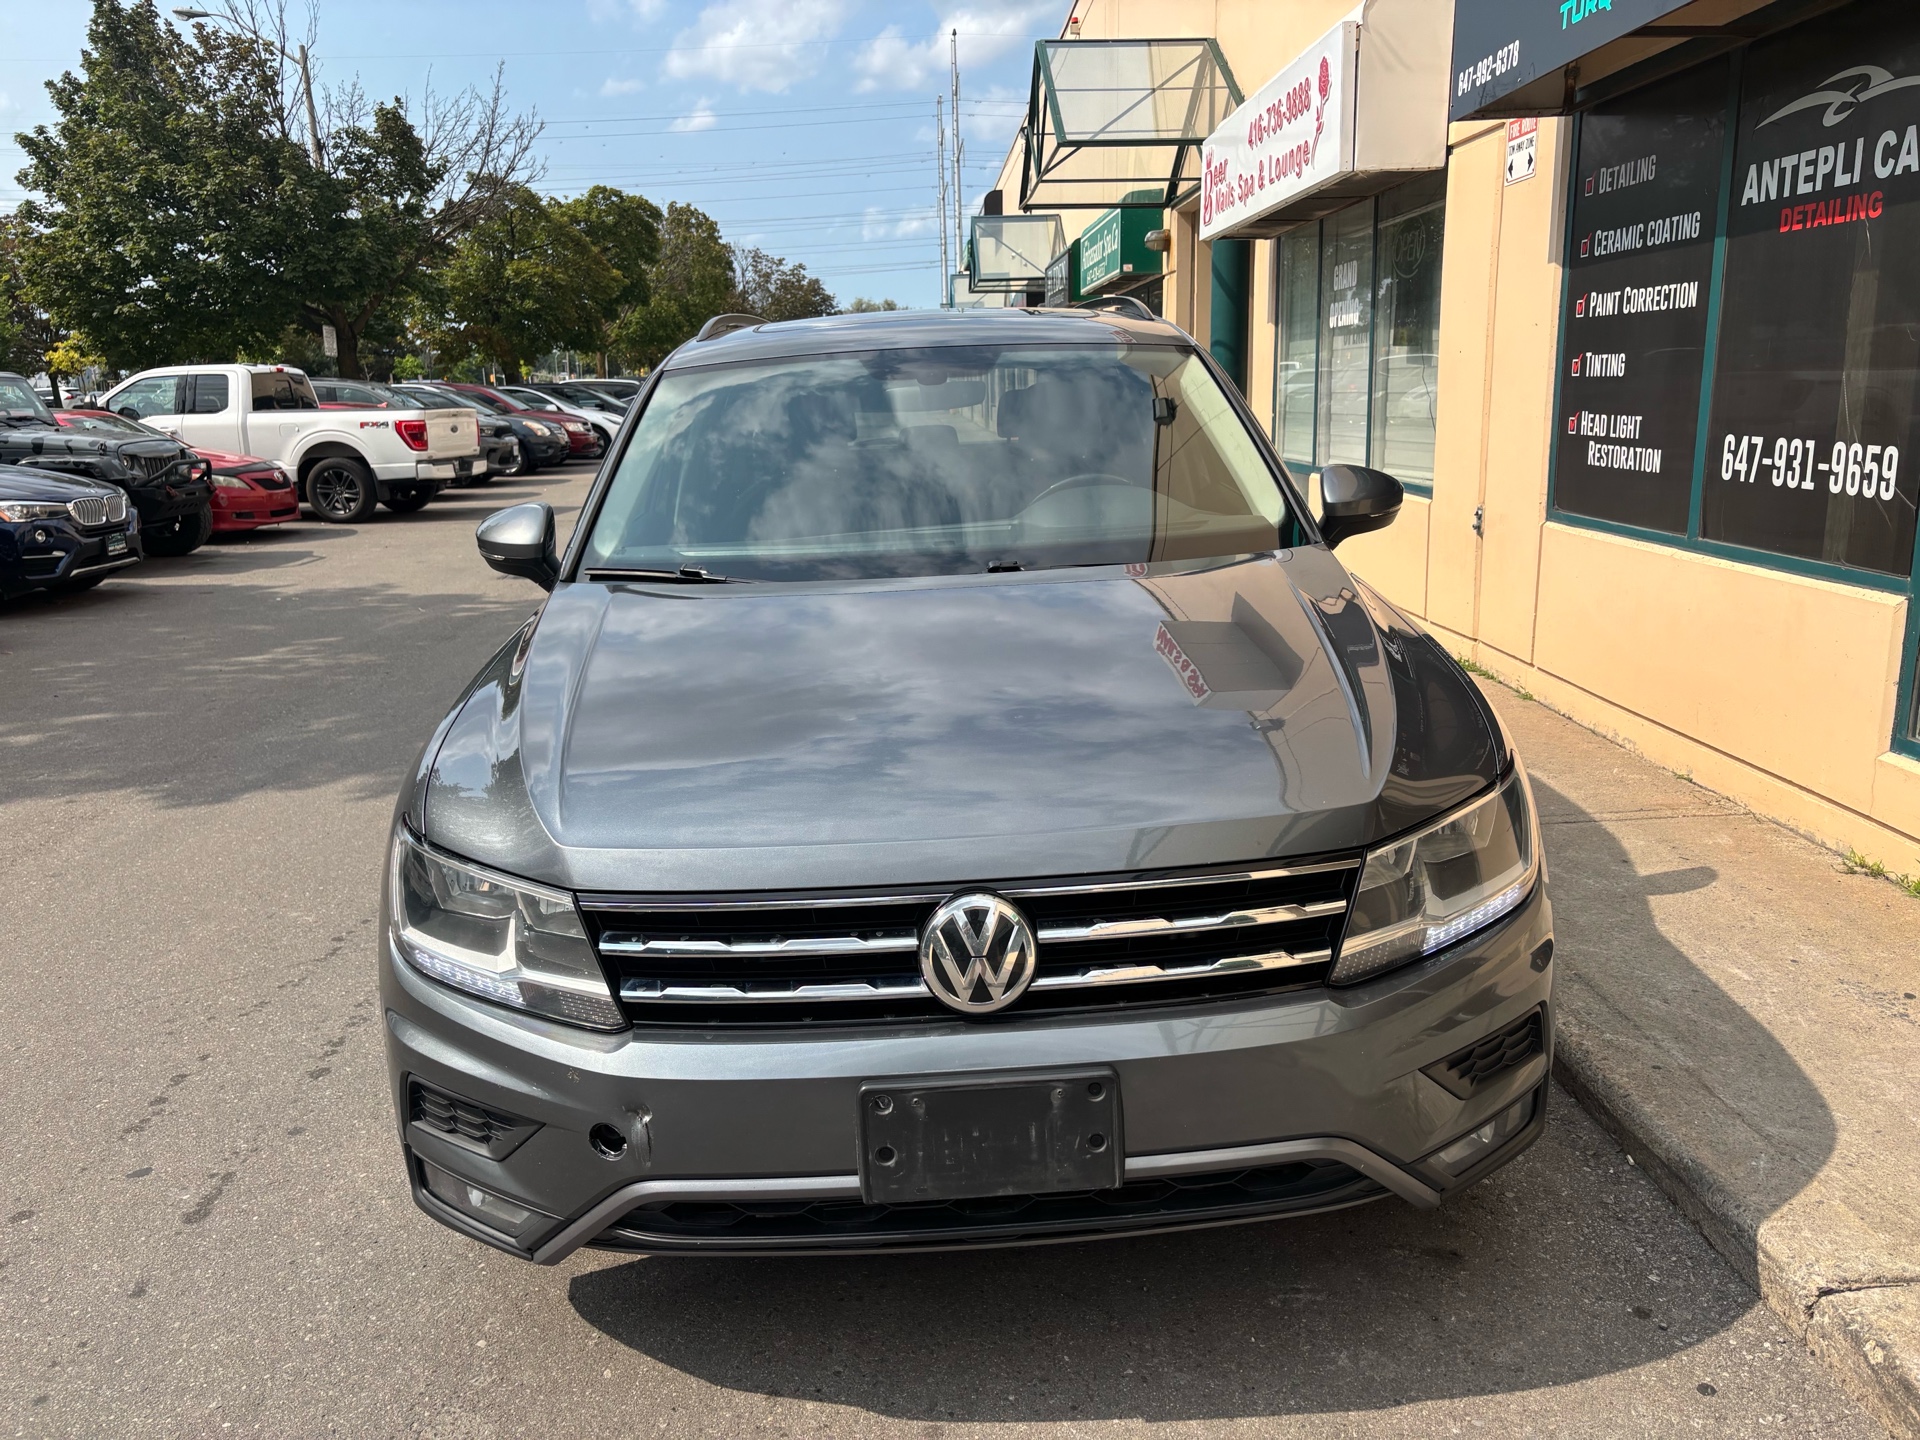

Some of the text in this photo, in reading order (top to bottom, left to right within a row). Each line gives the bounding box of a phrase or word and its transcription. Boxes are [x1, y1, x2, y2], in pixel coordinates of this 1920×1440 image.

[1458, 39, 1520, 97] 647-992-6378
[1248, 76, 1311, 151] 416-736-9888
[1214, 139, 1311, 216] Nails Spa & Lounge
[1599, 154, 1657, 195] DETAILING
[1741, 124, 1920, 206] ANTEPLI CA
[1779, 190, 1884, 233] DETAILING
[1594, 211, 1701, 257] CERAMIC COATING
[1333, 259, 1358, 292] GRAND
[1329, 297, 1359, 329] OPENING
[1589, 281, 1699, 318] PAINT CORRECTION
[1585, 352, 1626, 378] TINTING
[359, 421, 389, 430] FX4
[1580, 410, 1643, 440] HEAD LIGHT
[1587, 440, 1662, 474] RESTORATION
[1721, 433, 1900, 502] 647-931-9659
